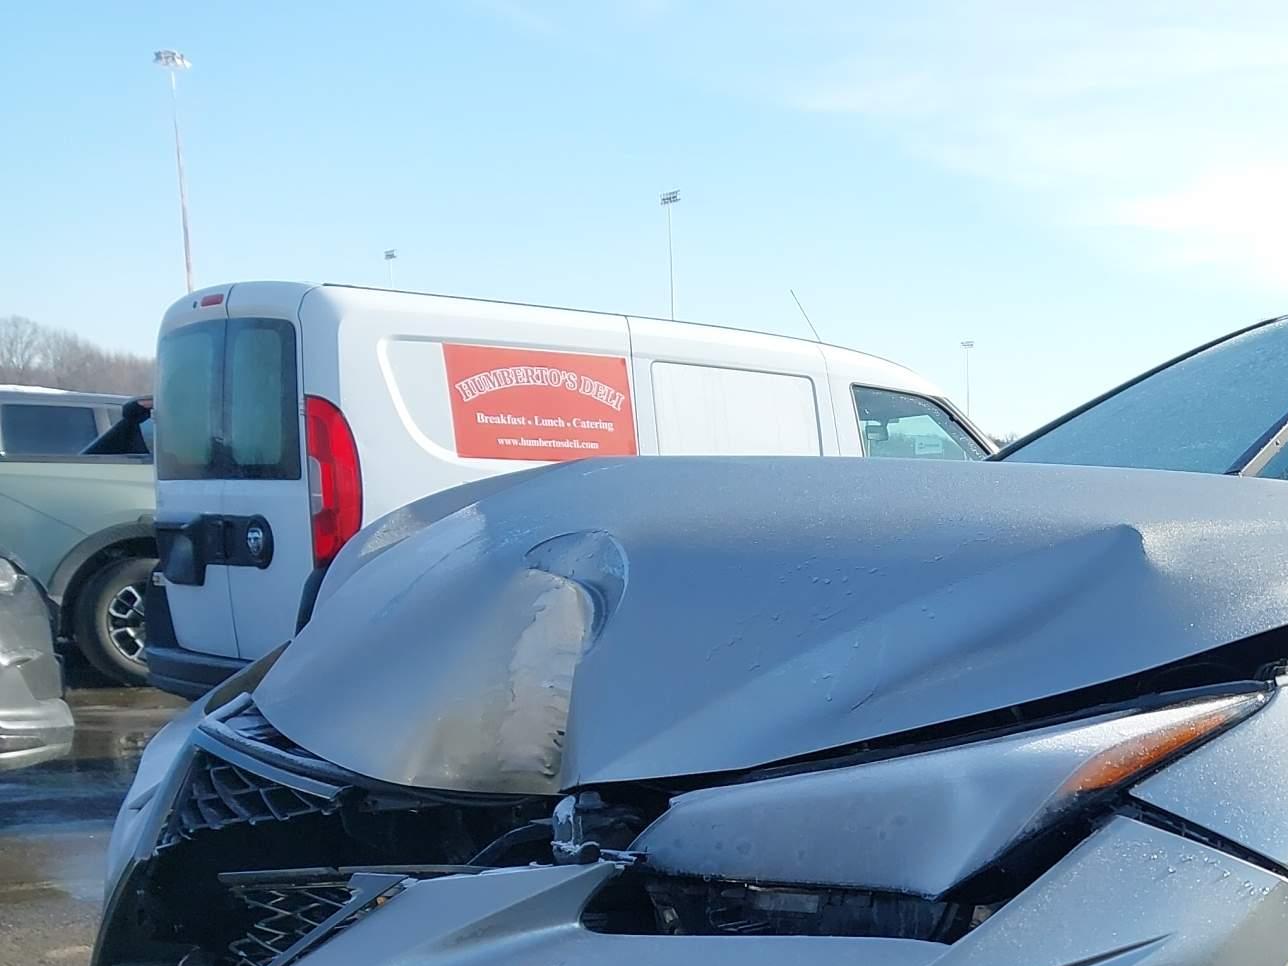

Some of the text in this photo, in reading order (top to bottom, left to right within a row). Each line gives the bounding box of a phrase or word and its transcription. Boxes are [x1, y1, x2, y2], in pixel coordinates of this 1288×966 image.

[455, 366, 625, 411] HUMBERTO'S DELI
[476, 412, 615, 432] Breakfast Lunch Catering
[497, 437, 600, 449] www.humbertosdeli.com
